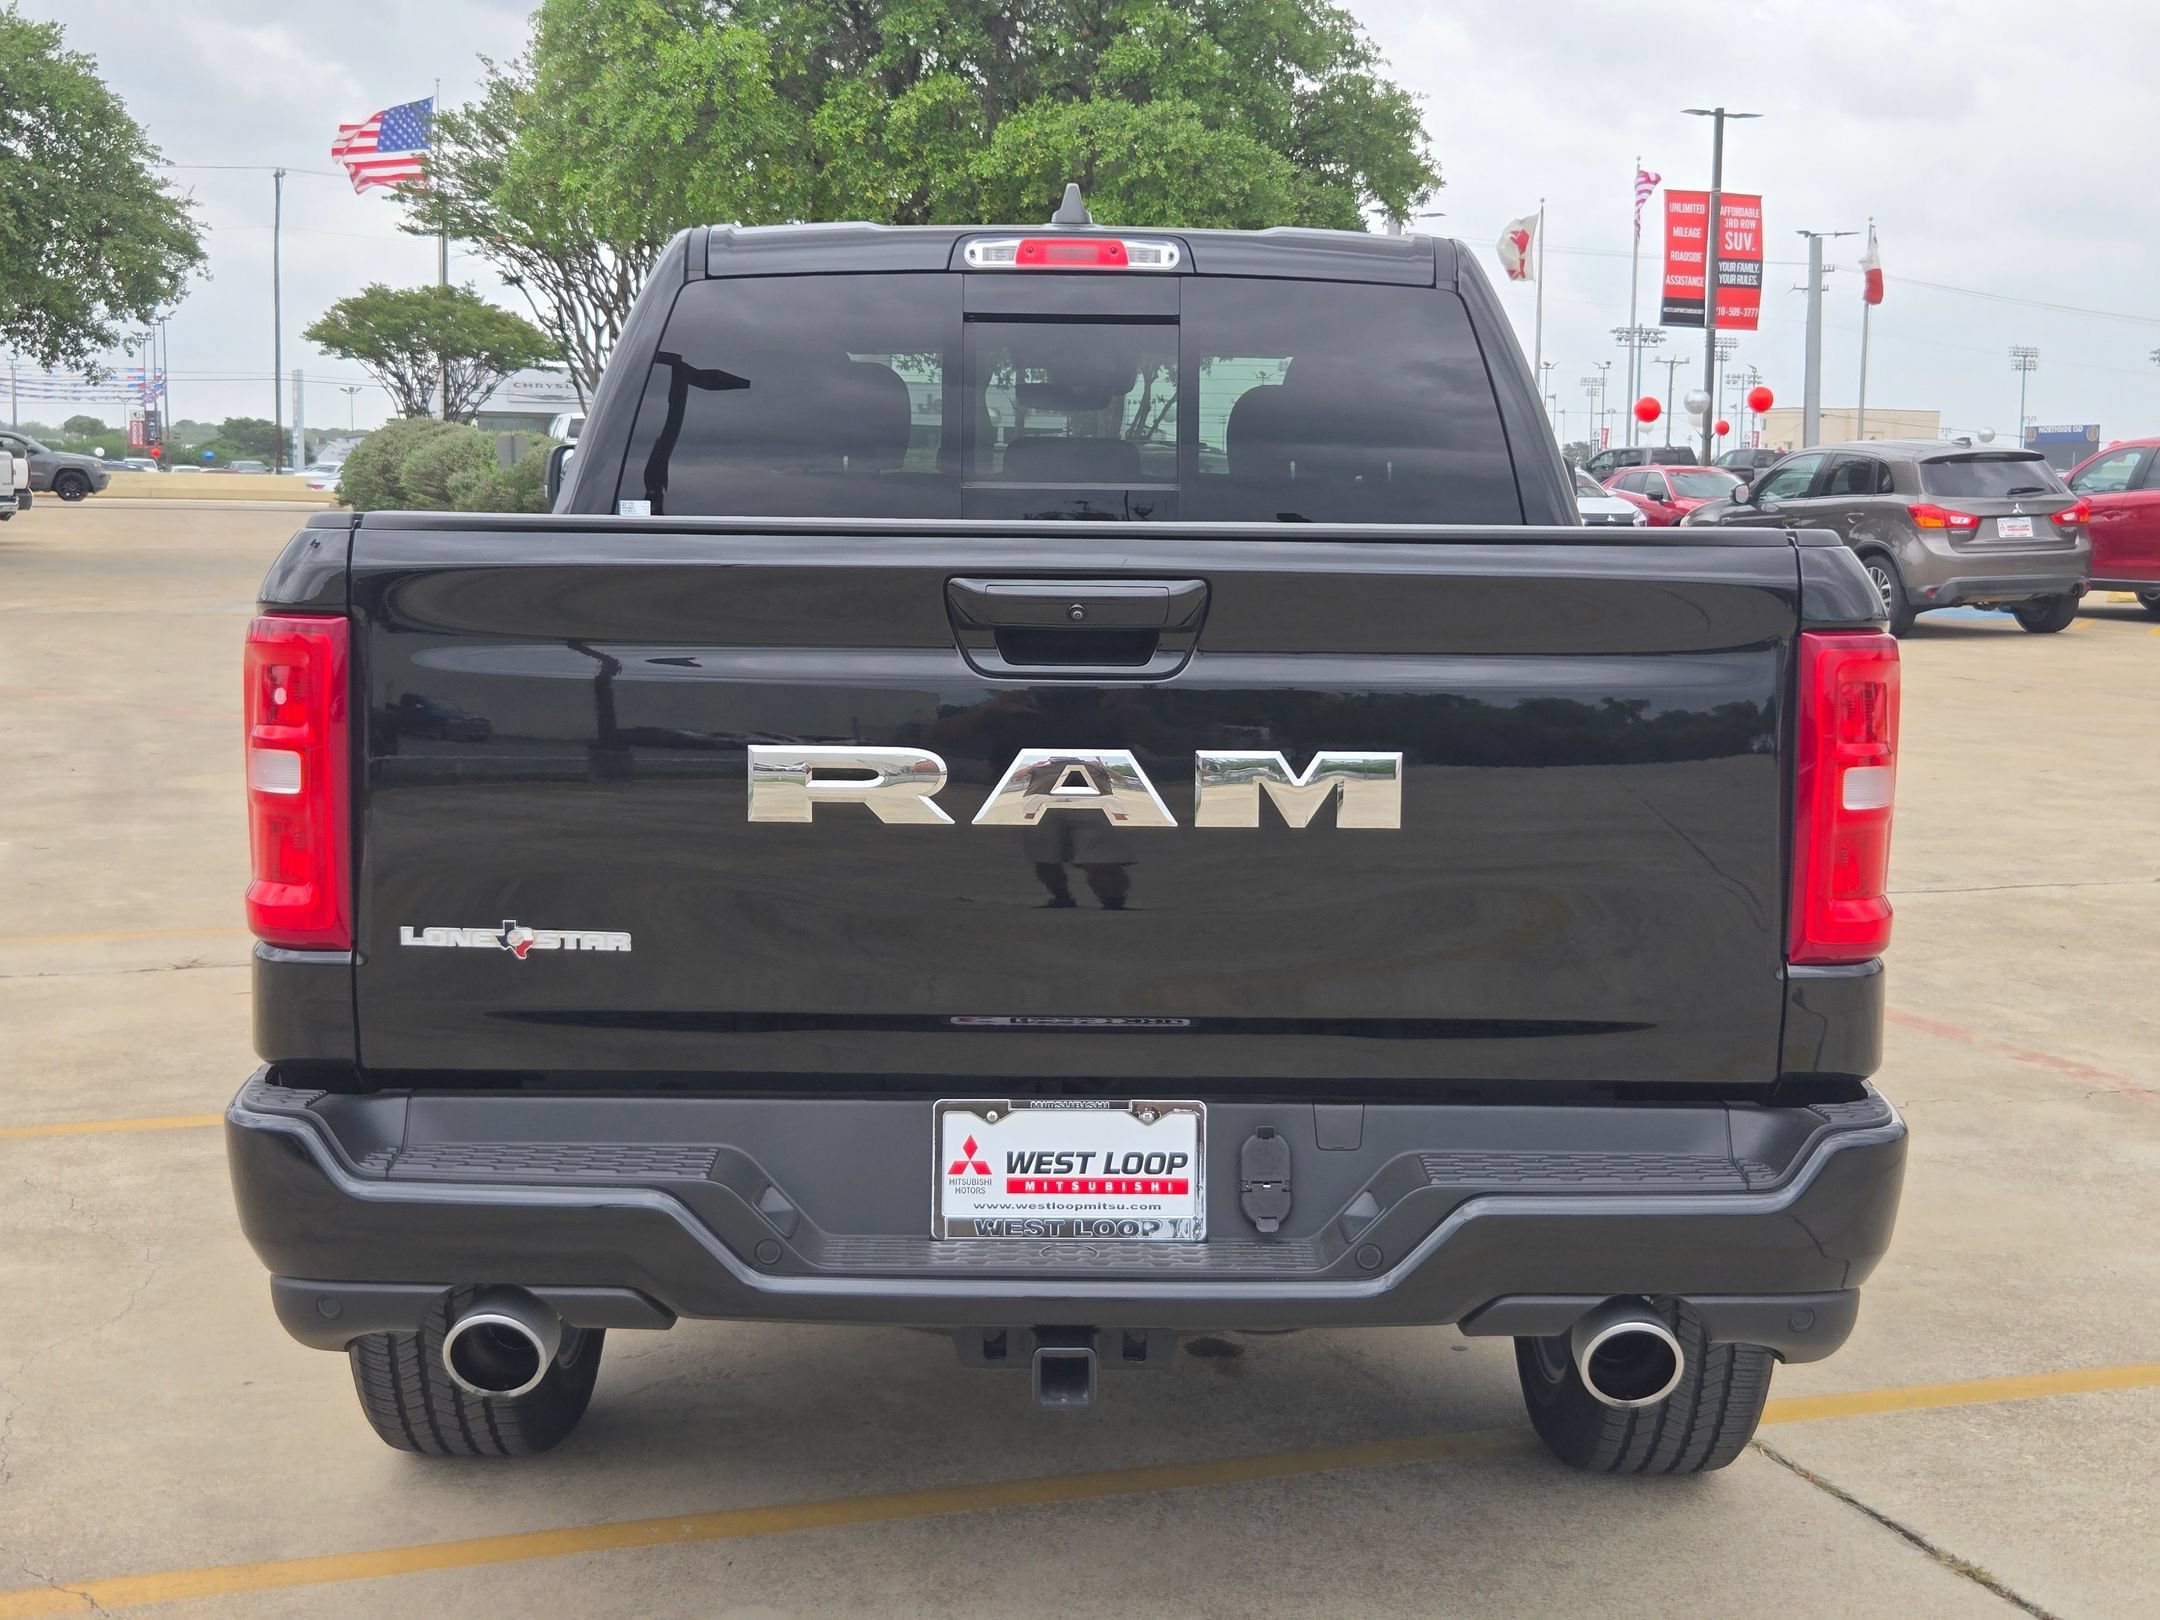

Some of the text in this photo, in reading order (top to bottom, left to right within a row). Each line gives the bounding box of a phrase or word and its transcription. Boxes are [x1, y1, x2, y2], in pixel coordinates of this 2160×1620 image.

[1669, 202, 1705, 214] UNLIMITED
[1720, 206, 1760, 218] AFFORDABLE
[1724, 218, 1756, 229] 3RD ROW
[1673, 227, 1702, 238] MILEAGE
[1725, 232, 1755, 251] SUV.
[1670, 250, 1702, 262] ROADSIDE
[1718, 261, 1760, 273] YOUR FAMILY.
[1665, 274, 1704, 287] ASSISTANCE
[1718, 273, 1736, 285] YOUR
[747, 745, 1403, 829] RAM
[400, 926, 631, 951] LONE STAR
[1030, 1100, 1110, 1109] MITSUBISHI
[1006, 1151, 1189, 1175] WEST LOOP
[949, 1178, 992, 1187] MITSUBISHI
[1024, 1181, 1173, 1192] MITSUBISHI
[954, 1187, 986, 1195] MOTORS
[973, 1202, 1162, 1212] www.westloopmitsu.com
[974, 1218, 1161, 1238] WEST LOOP
